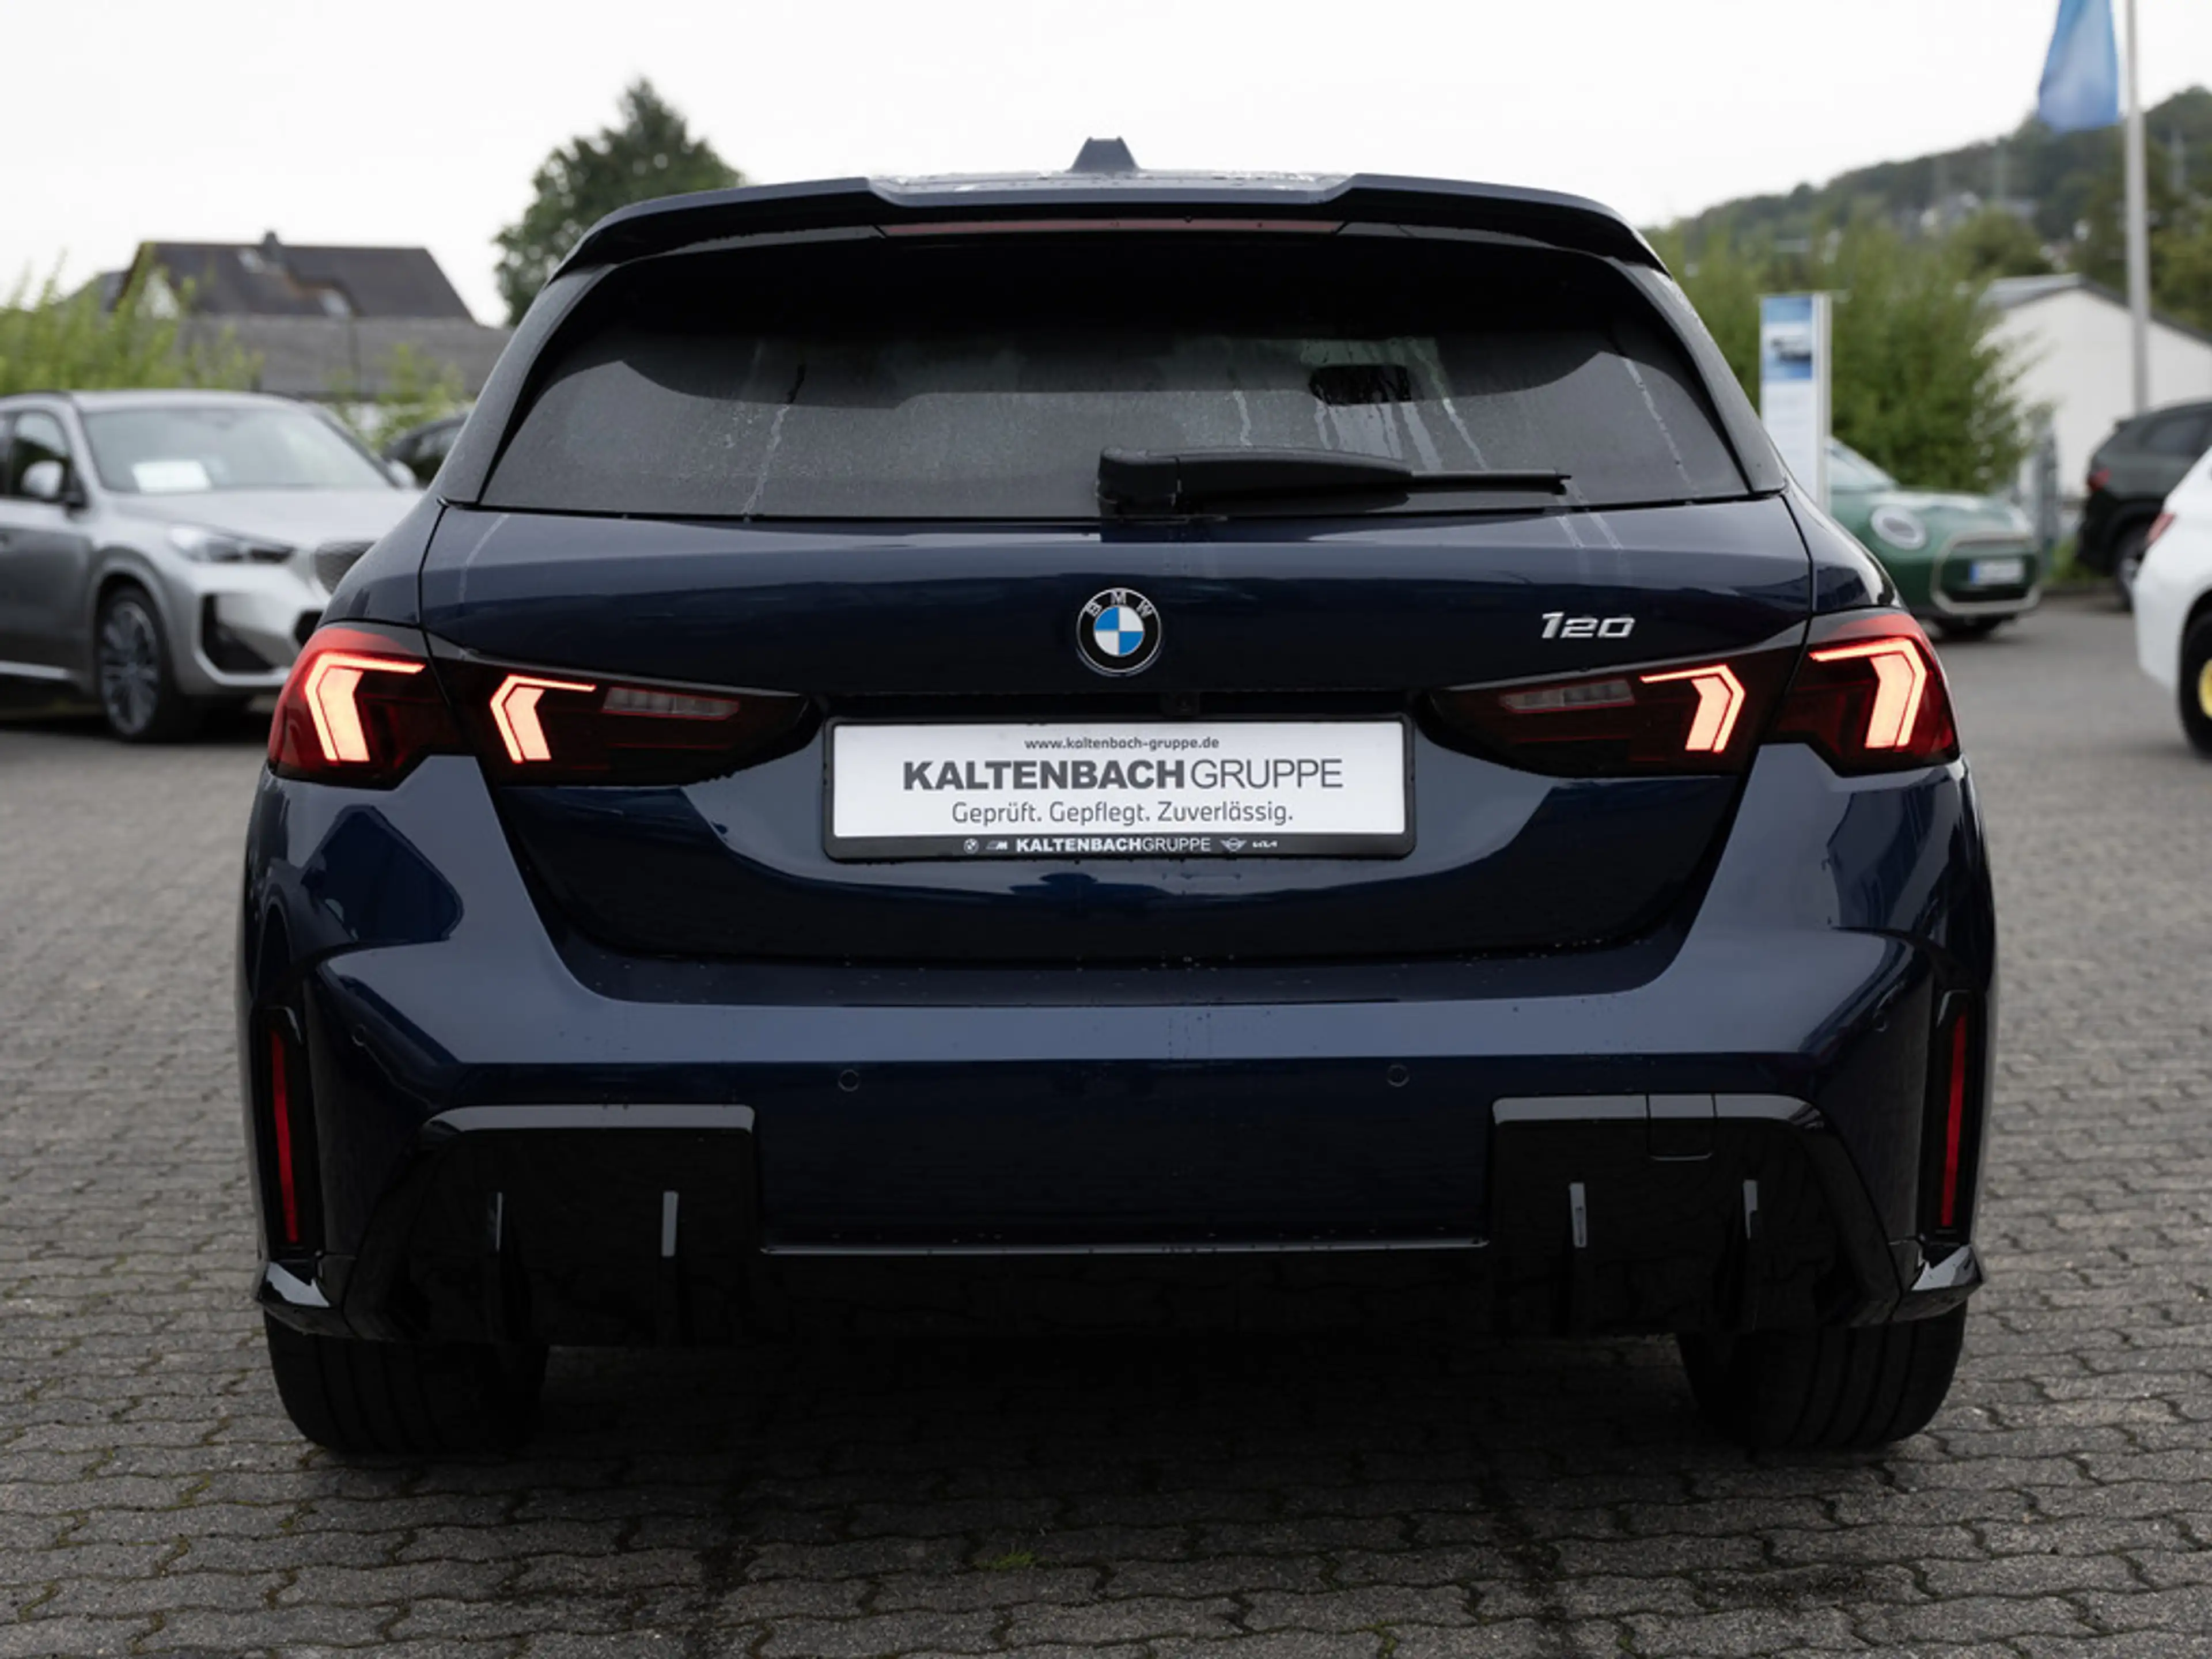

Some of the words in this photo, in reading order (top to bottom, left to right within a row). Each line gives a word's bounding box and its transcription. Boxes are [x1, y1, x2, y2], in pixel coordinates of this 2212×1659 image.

[1085, 590, 1153, 619] BMW
[1541, 611, 1635, 638] 120
[1024, 737, 1219, 751] www.kaltenbach-gruppe.de
[952, 801, 1042, 825] Geprüft.
[1049, 801, 1150, 826] Gepflegt.
[1157, 801, 1293, 826] Zuverlässig.
